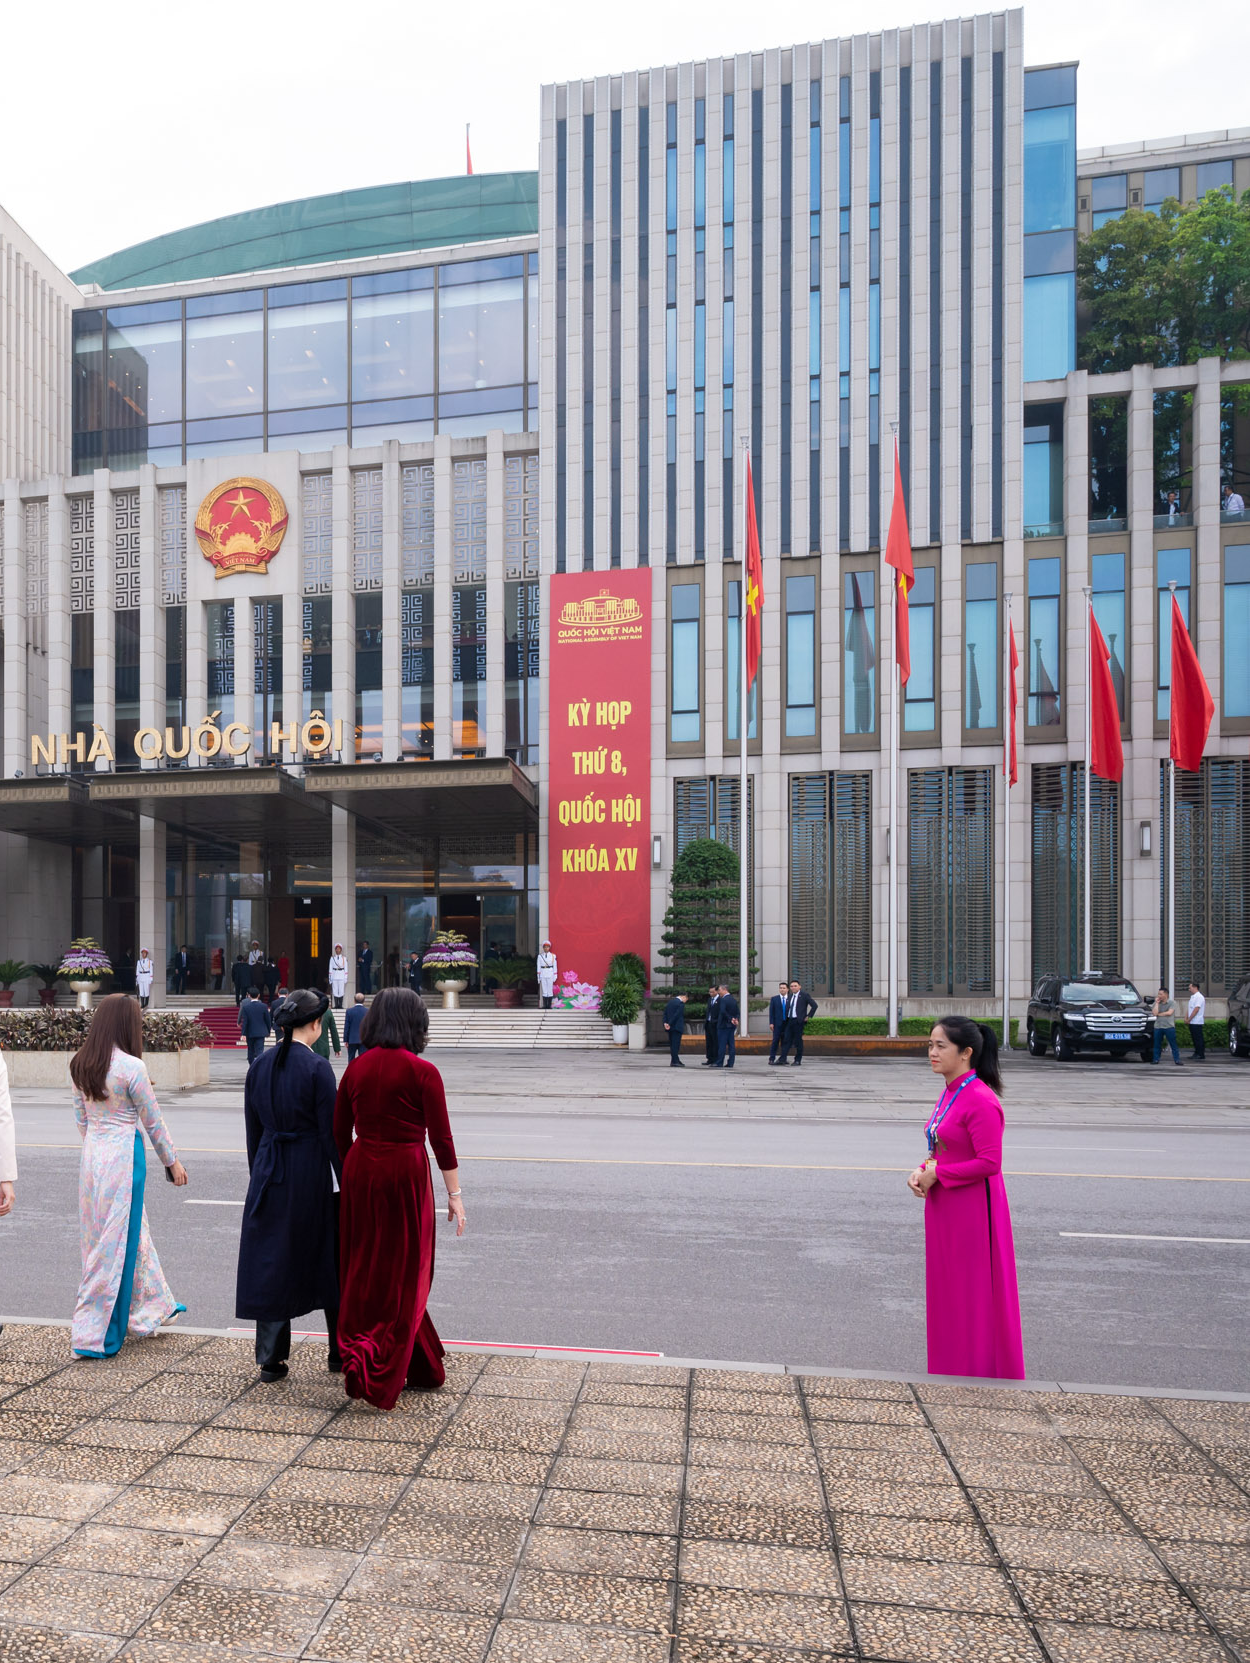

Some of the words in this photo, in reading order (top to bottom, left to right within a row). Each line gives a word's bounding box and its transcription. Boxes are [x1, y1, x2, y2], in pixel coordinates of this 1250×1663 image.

[558, 628, 582, 637] QUỐC
[584, 627, 598, 637] HỘI
[600, 625, 620, 635] VIỆT
[569, 698, 590, 726] KỲ
[596, 701, 631, 729] HỌP
[31, 723, 115, 766] NHÀ
[134, 710, 251, 760] QUỐC
[271, 709, 344, 759] HỘI
[572, 746, 607, 774] THỨ
[611, 751, 626, 776] 8,
[559, 792, 605, 826] QUỐC
[612, 794, 640, 827] HỘI
[563, 844, 609, 872] KHÓA
[615, 848, 637, 871] XV
